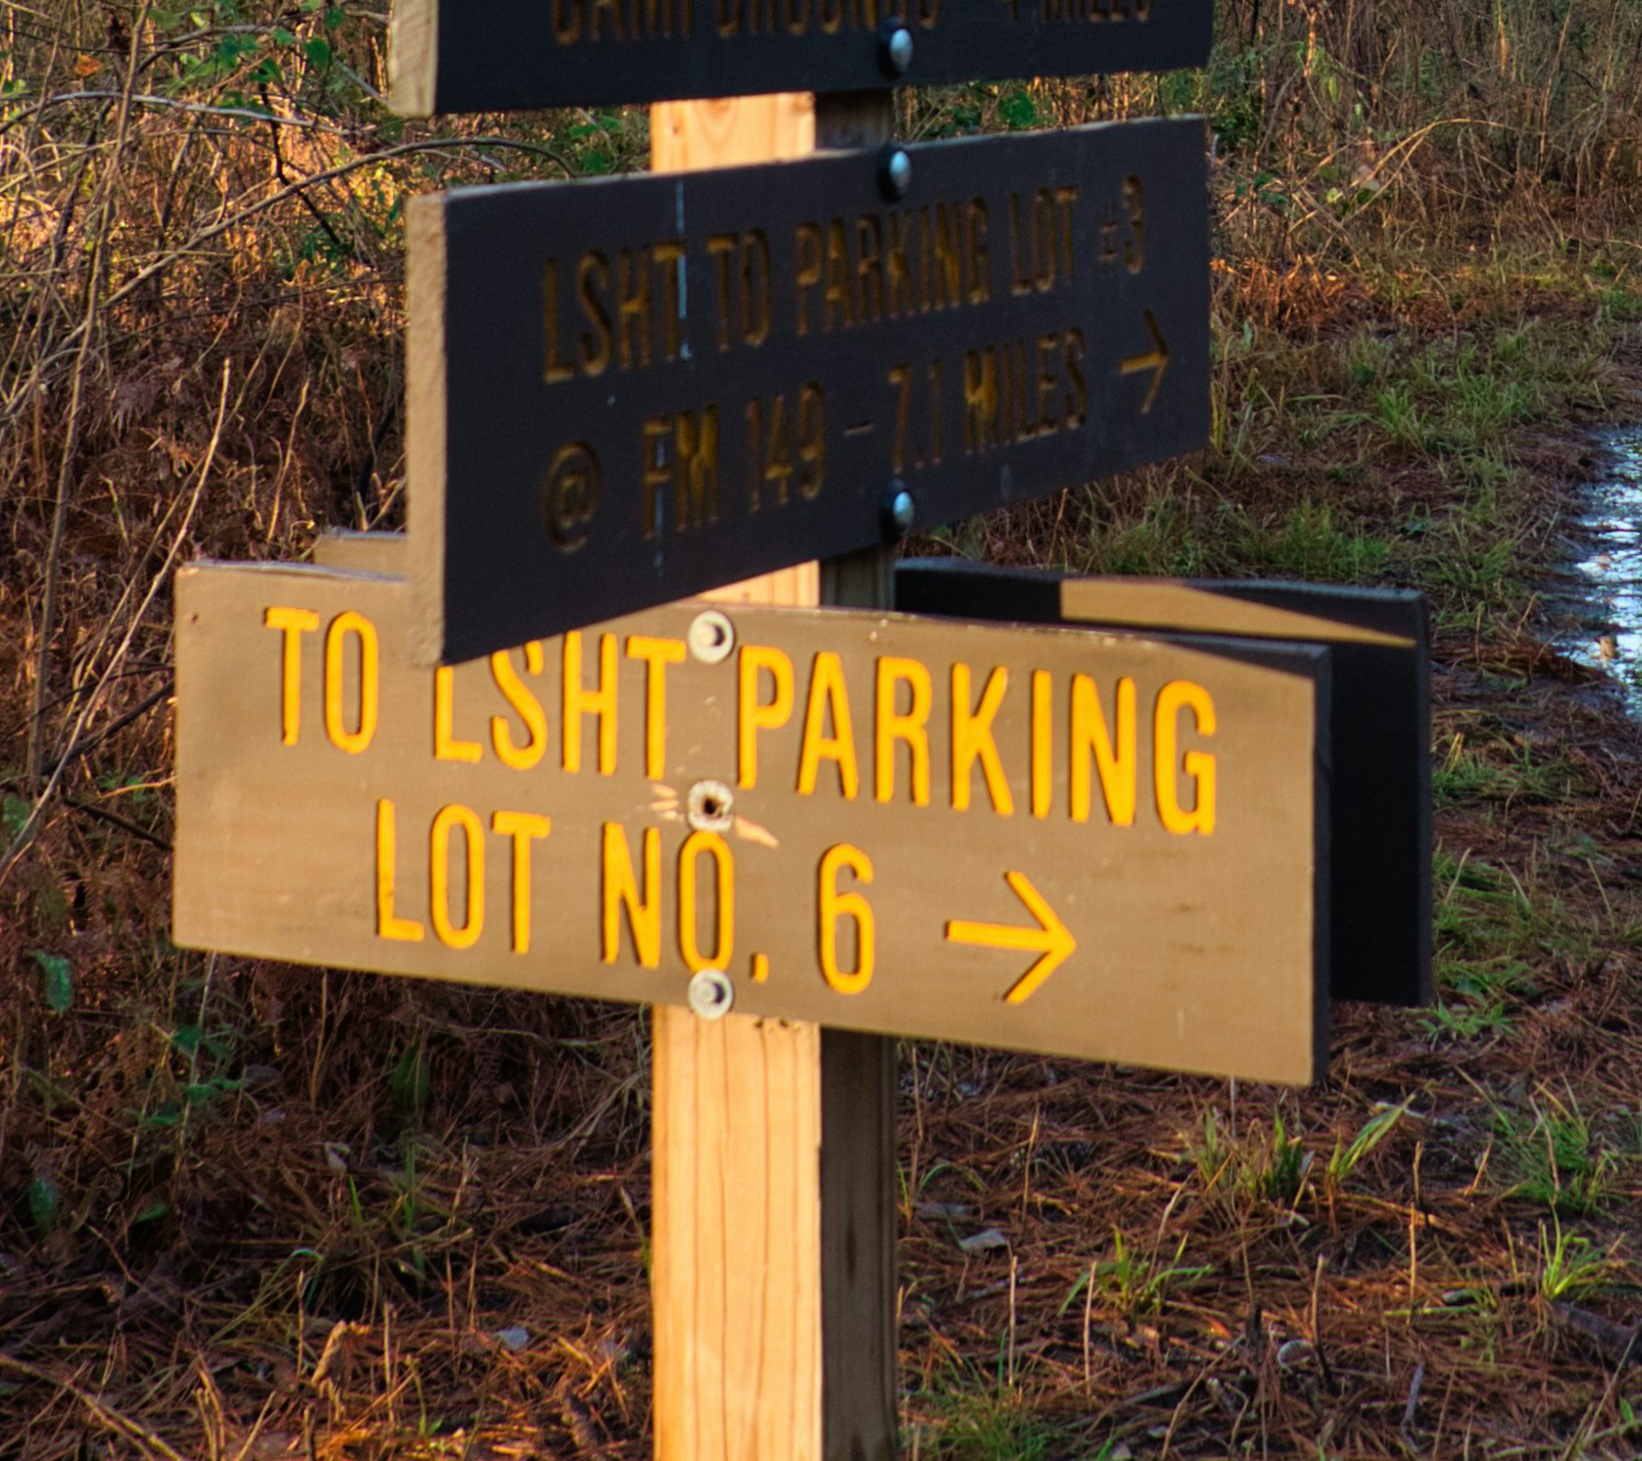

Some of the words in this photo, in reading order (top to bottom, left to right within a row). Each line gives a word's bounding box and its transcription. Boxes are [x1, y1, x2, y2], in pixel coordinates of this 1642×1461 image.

[541, 241, 685, 384] LSHT
[707, 229, 771, 352] TO
[796, 196, 990, 337] PARKING
[1011, 186, 1079, 296] LOT
[1097, 175, 1145, 275] #3
[544, 441, 602, 553] @
[642, 403, 720, 541] FM
[746, 381, 827, 513] 149
[888, 362, 943, 474] 7.1
[963, 326, 1088, 456] MILES
[265, 607, 378, 754] TO
[434, 632, 686, 780] LSHT
[739, 646, 1216, 835] PARKING
[377, 799, 550, 954] LOT
[602, 822, 768, 983] NO.
[819, 843, 874, 994] 6
